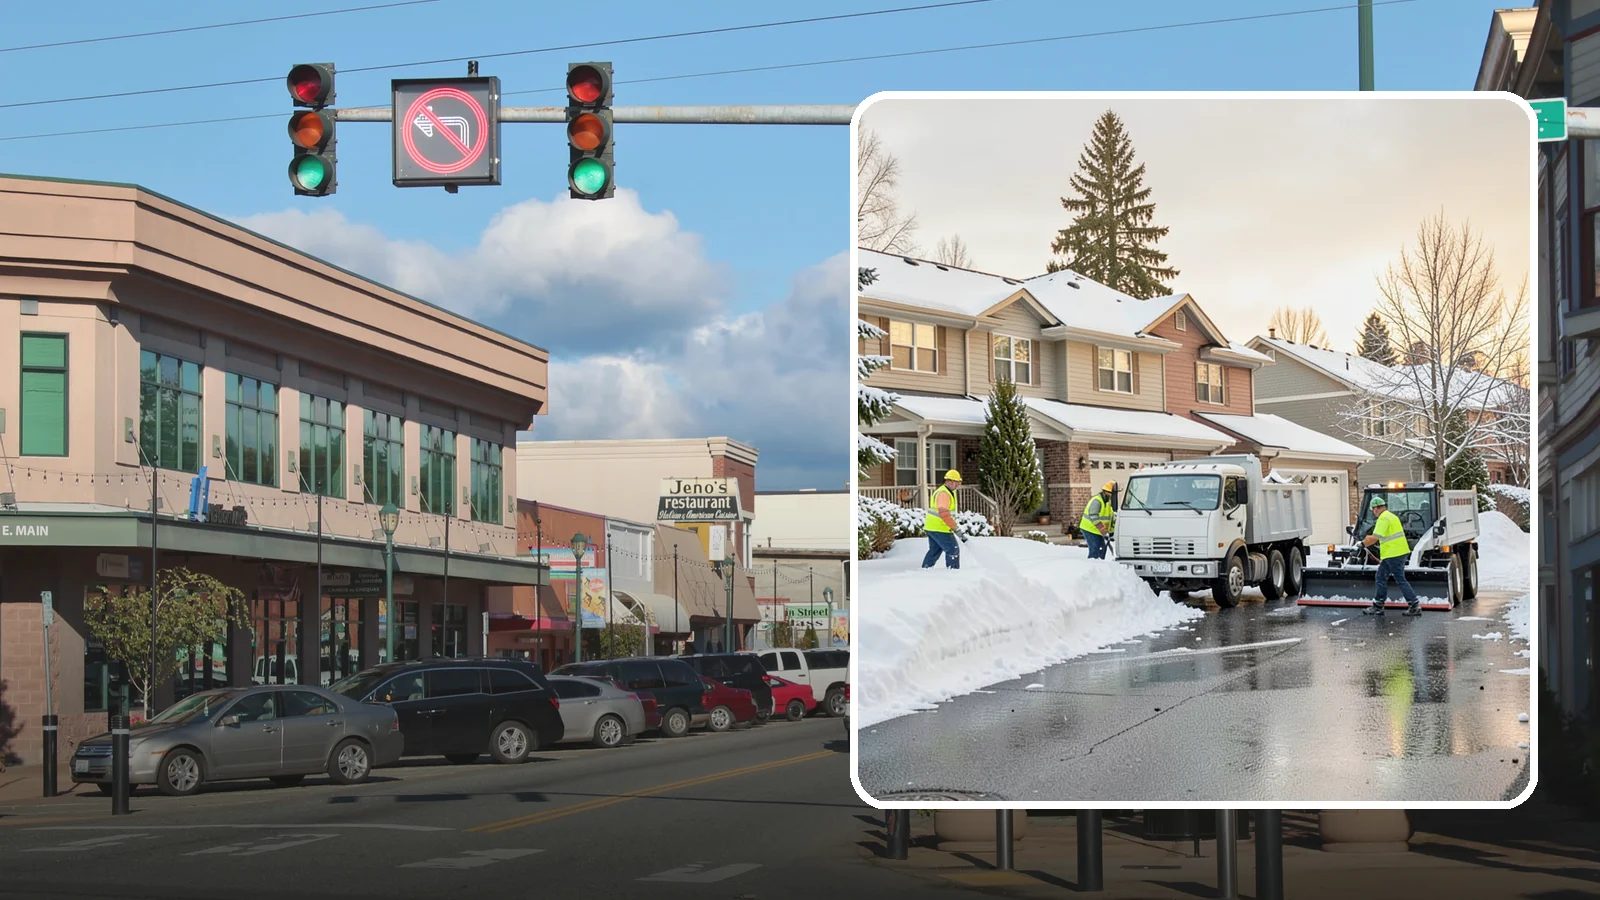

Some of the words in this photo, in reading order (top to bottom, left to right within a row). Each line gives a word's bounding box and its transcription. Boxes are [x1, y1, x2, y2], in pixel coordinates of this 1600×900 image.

[669, 480, 728, 494] Jeno's
[665, 496, 731, 509] restaurant
[658, 510, 682, 520] Italian
[685, 510, 715, 519] American
[714, 509, 738, 519] Cuisine
[2, 525, 13, 536] E.
[15, 525, 49, 536] MAIN
[797, 607, 829, 617] Street
[790, 619, 824, 627] lass
